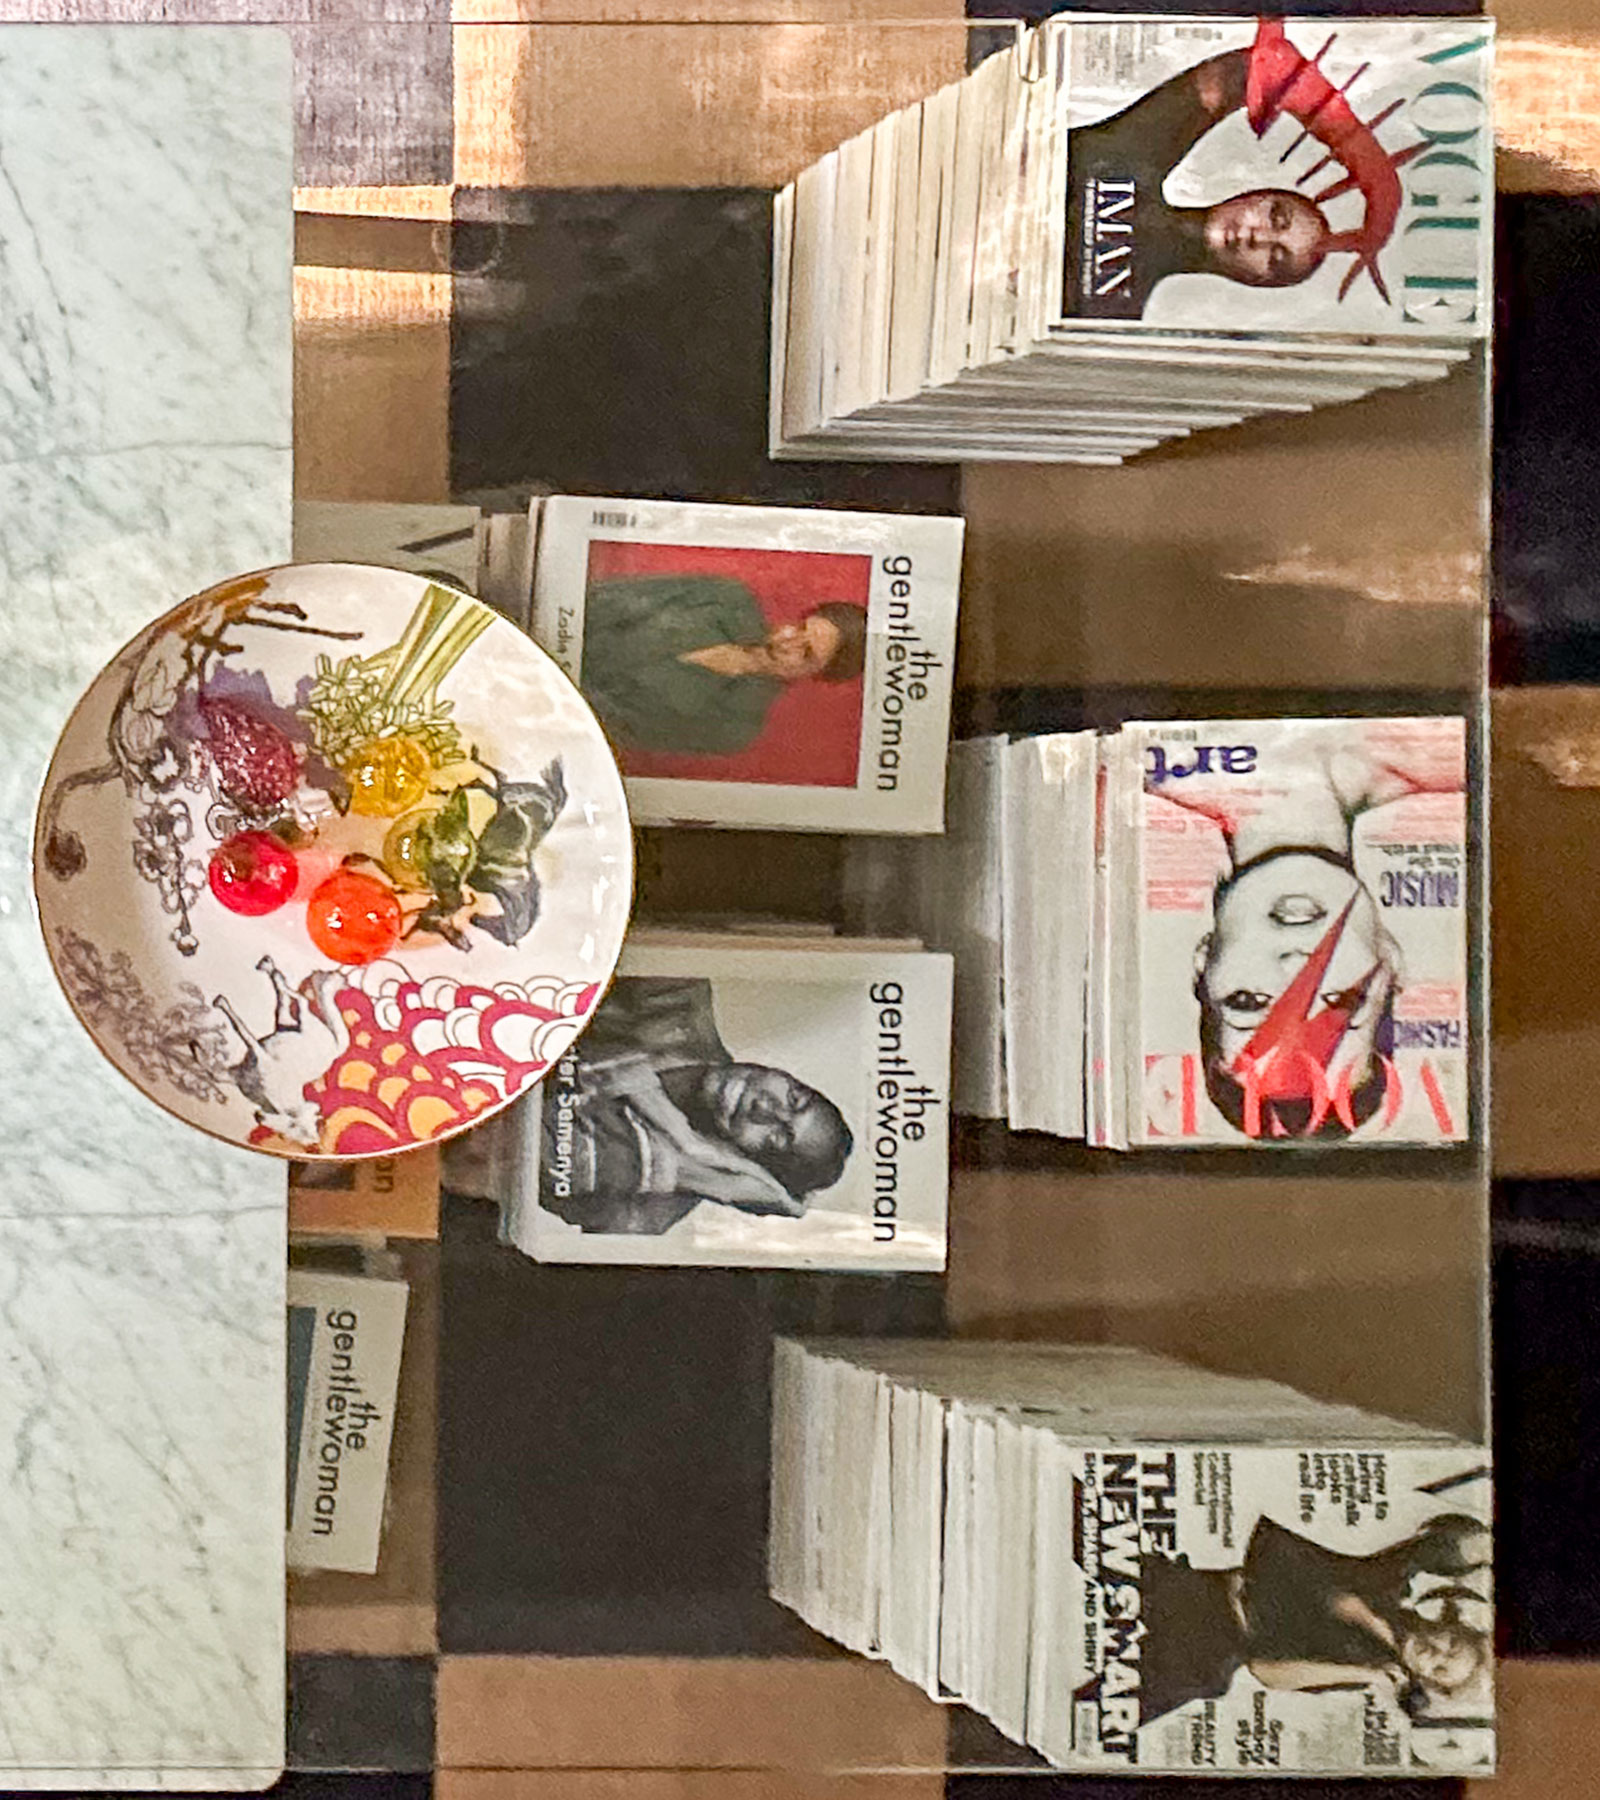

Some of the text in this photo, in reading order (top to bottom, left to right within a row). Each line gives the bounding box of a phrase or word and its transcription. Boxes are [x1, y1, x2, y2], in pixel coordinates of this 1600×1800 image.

[1402, 35, 1488, 324] VOGUE
[1095, 179, 1136, 298] IMAN
[555, 606, 575, 654] Zadie
[877, 555, 921, 792] gentlewoman
[908, 651, 943, 701] the
[1145, 746, 1257, 783] art
[1380, 871, 1459, 908] MUSIC
[548, 1092, 580, 1197] Semenya
[870, 981, 916, 1242] gentlewoman
[902, 1086, 941, 1142] the
[313, 1309, 361, 1536] gentlewoman
[346, 1402, 381, 1450] the
[1141, 1453, 1177, 1553] THE
[1085, 1580, 1097, 1617] AND
[1100, 1453, 1143, 1764] NEW SMART
